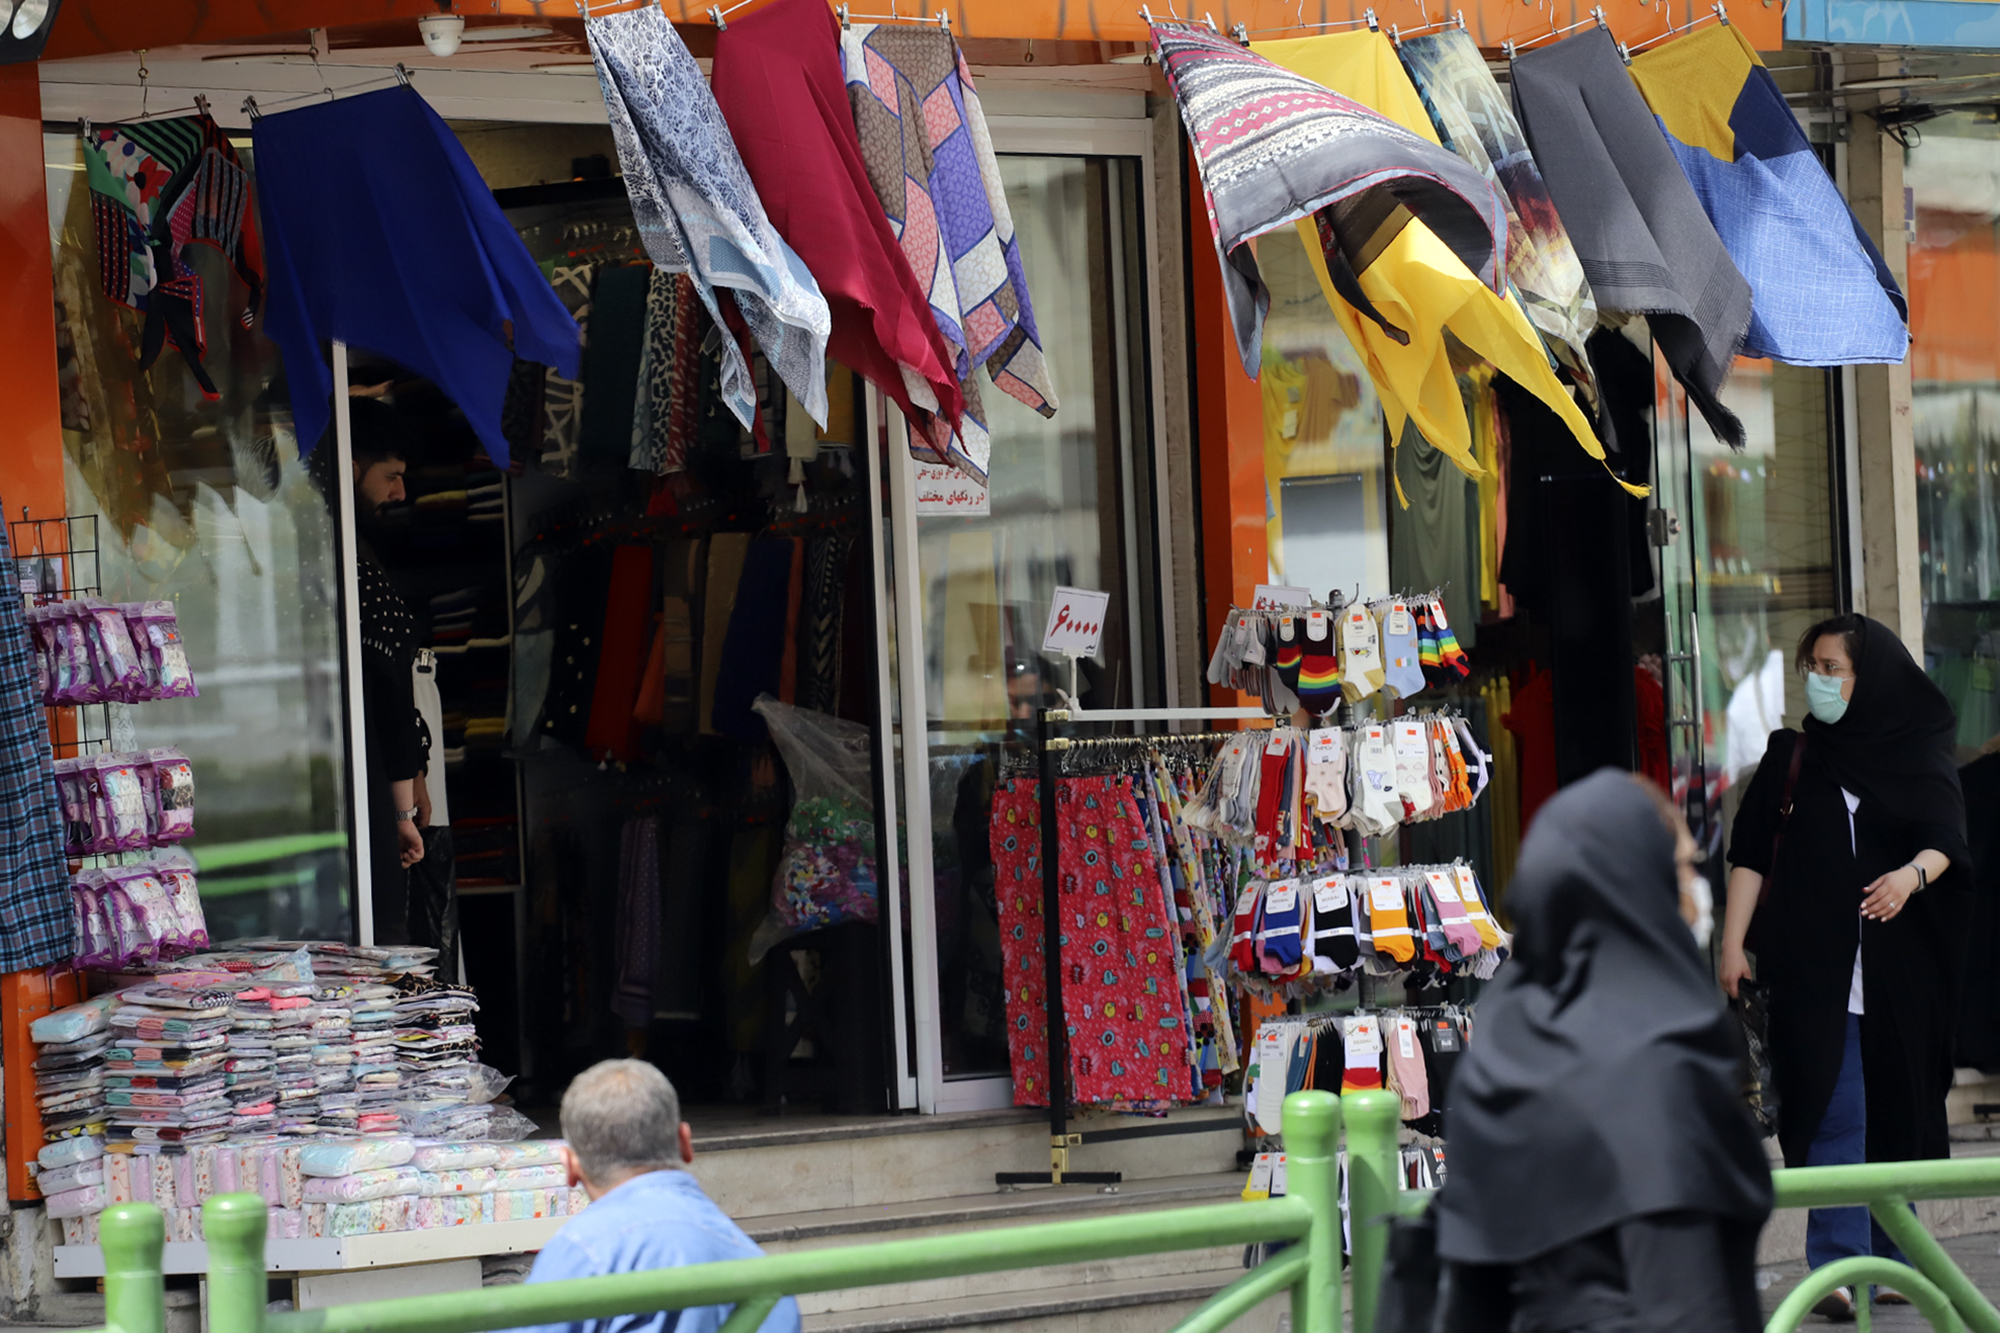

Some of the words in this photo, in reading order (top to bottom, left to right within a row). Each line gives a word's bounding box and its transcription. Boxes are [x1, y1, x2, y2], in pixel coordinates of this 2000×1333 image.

[917, 489, 944, 503] مختلف
[946, 489, 973, 506] رنگهای
[975, 491, 985, 505] در
[1050, 603, 1099, 638] ۶۰۰۰۰
